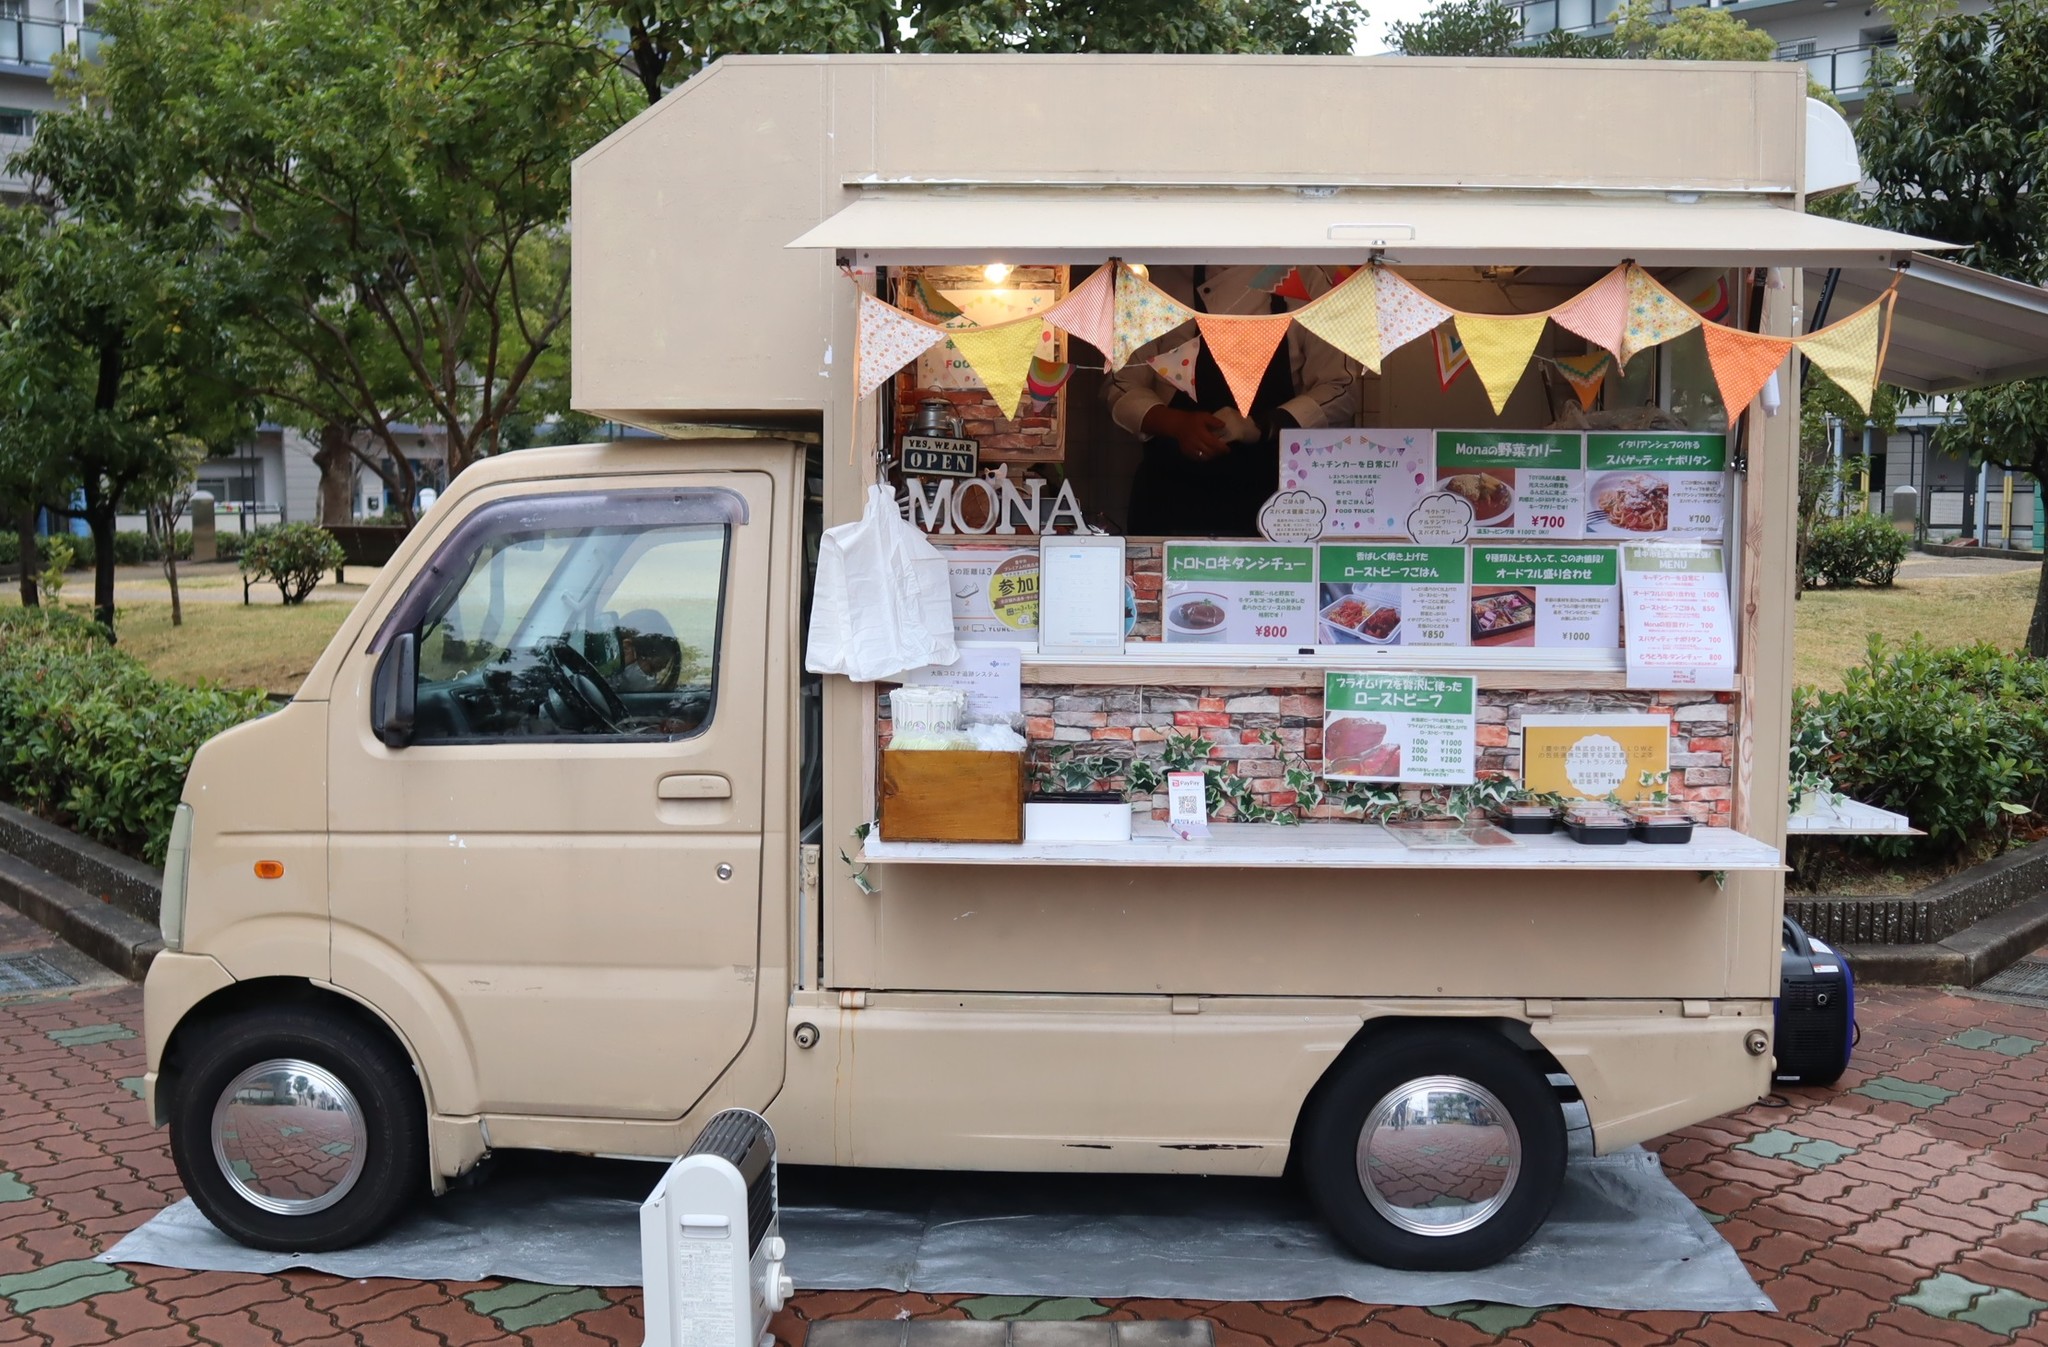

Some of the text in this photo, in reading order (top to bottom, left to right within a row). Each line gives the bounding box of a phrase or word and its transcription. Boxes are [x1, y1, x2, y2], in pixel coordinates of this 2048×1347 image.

[946, 360, 971, 369] FOO
[909, 439, 972, 451] YES, WE ARE
[1455, 442, 1562, 458] Monaの野菜カリー
[1617, 440, 1701, 450] イタリアンシェフの作る
[910, 451, 969, 471] OPEN
[1606, 454, 1712, 466] スパゲッティ・ナポリタン
[906, 478, 1092, 535] MONA
[1531, 516, 1565, 528] ¥700
[1689, 514, 1711, 524] ¥700
[1356, 551, 1429, 562] 香ばしく焼き上げた
[1172, 556, 1307, 571] トロトロ牛タンシチュー
[1659, 560, 1688, 569] MENU
[1344, 566, 1439, 578] ローストビーフごはん
[1496, 568, 1593, 580] オードブル盛り合わせ
[998, 575, 1039, 597] 参加
[1255, 625, 1288, 638] ¥800
[1422, 630, 1445, 639] ¥850
[1562, 632, 1590, 641] ¥1000
[1336, 677, 1463, 692] プライムリブを贅沢に使った
[1354, 692, 1443, 708] ローストビーフ
[1412, 738, 1462, 747] 100g ¥1000
[1411, 746, 1462, 755] 200g ¥1900
[1411, 755, 1462, 764] 300g ¥2800
